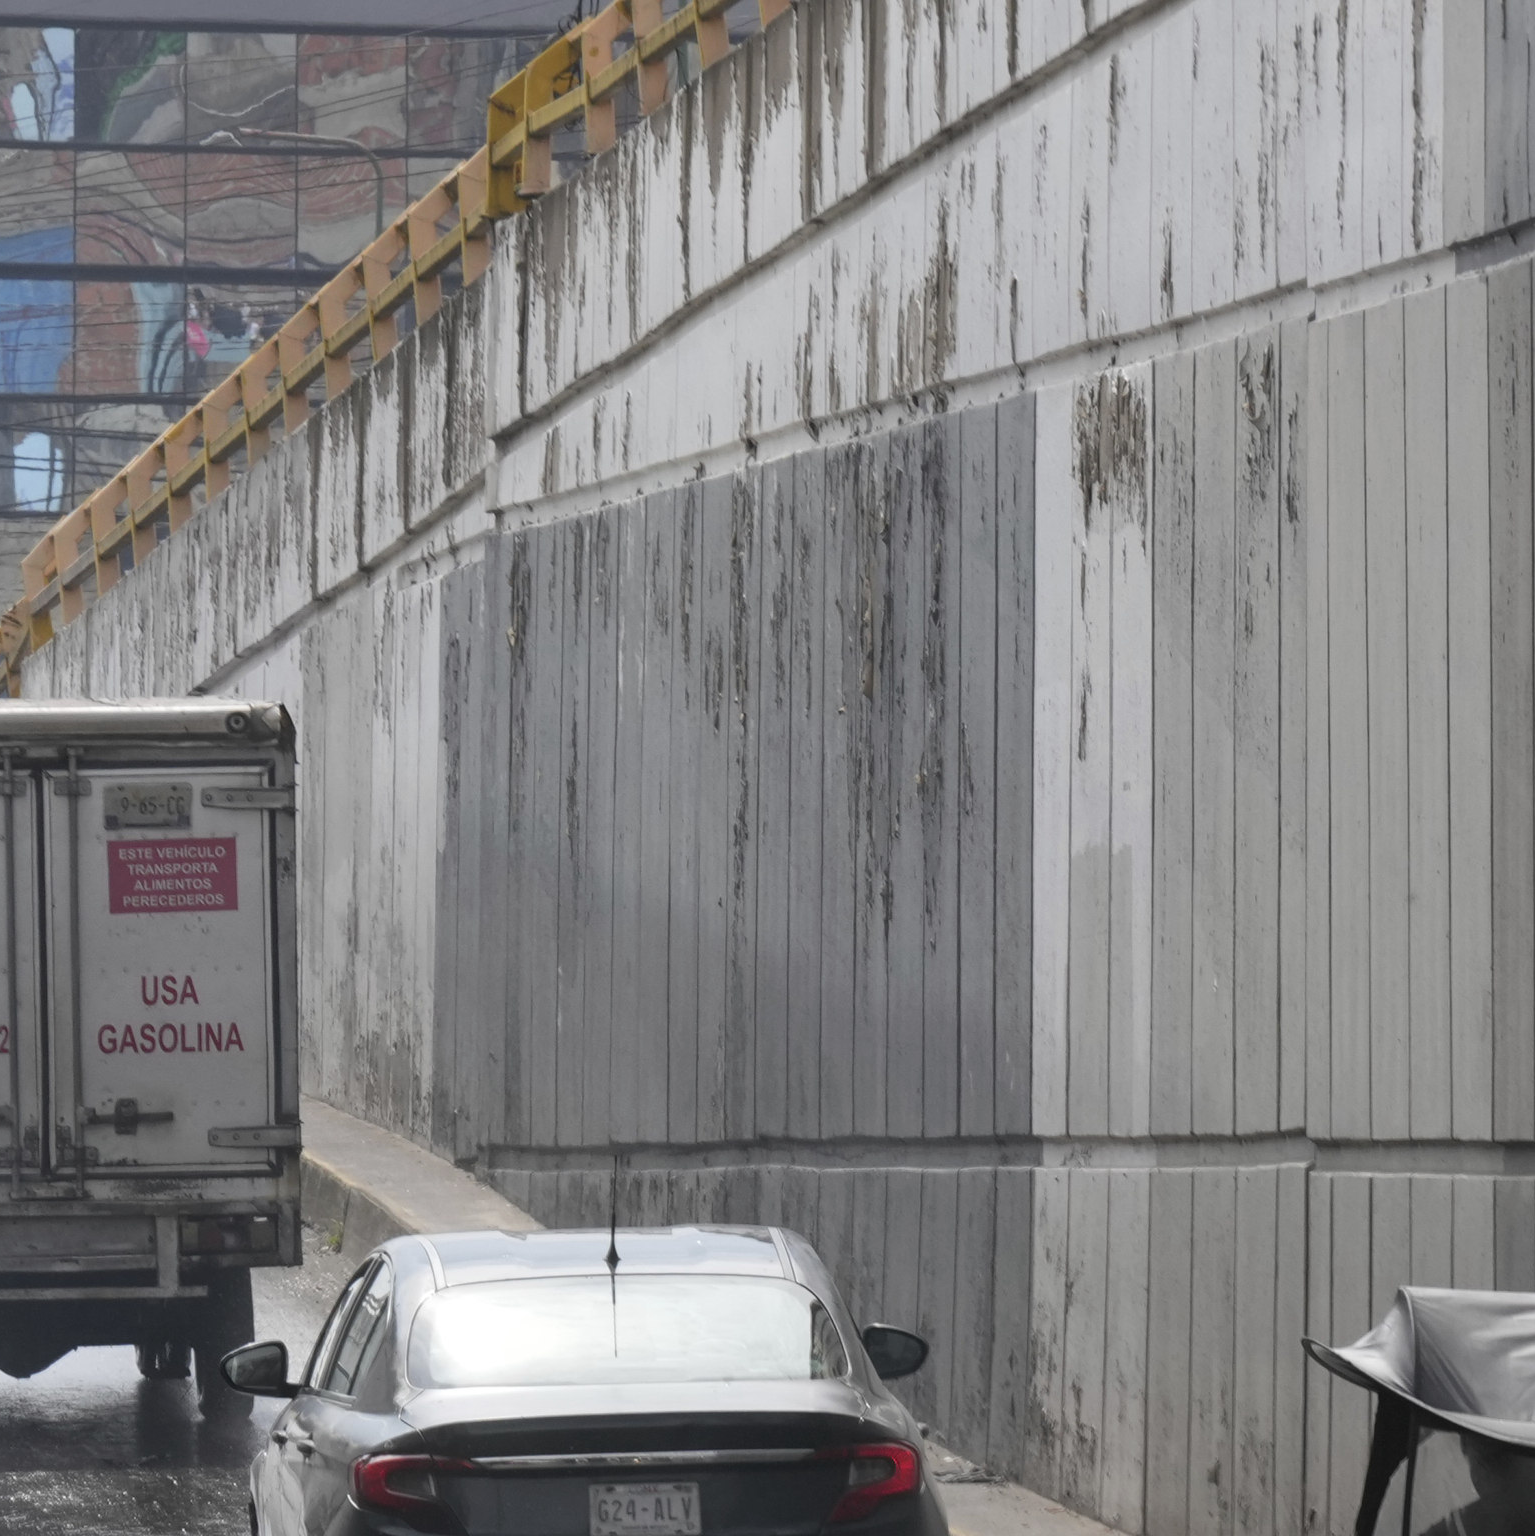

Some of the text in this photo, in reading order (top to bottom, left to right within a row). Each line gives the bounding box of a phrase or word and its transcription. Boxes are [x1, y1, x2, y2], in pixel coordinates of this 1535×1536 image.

[118, 844, 226, 860] ESTE VEHÍCULO
[127, 862, 218, 875] TRANSPORTA
[134, 878, 212, 891] ALIMENTOS
[122, 893, 225, 908] PERECEDEROS
[141, 975, 199, 1006] USA
[97, 1022, 245, 1054] GASOLINA
[598, 1497, 692, 1523] G24-ALV
